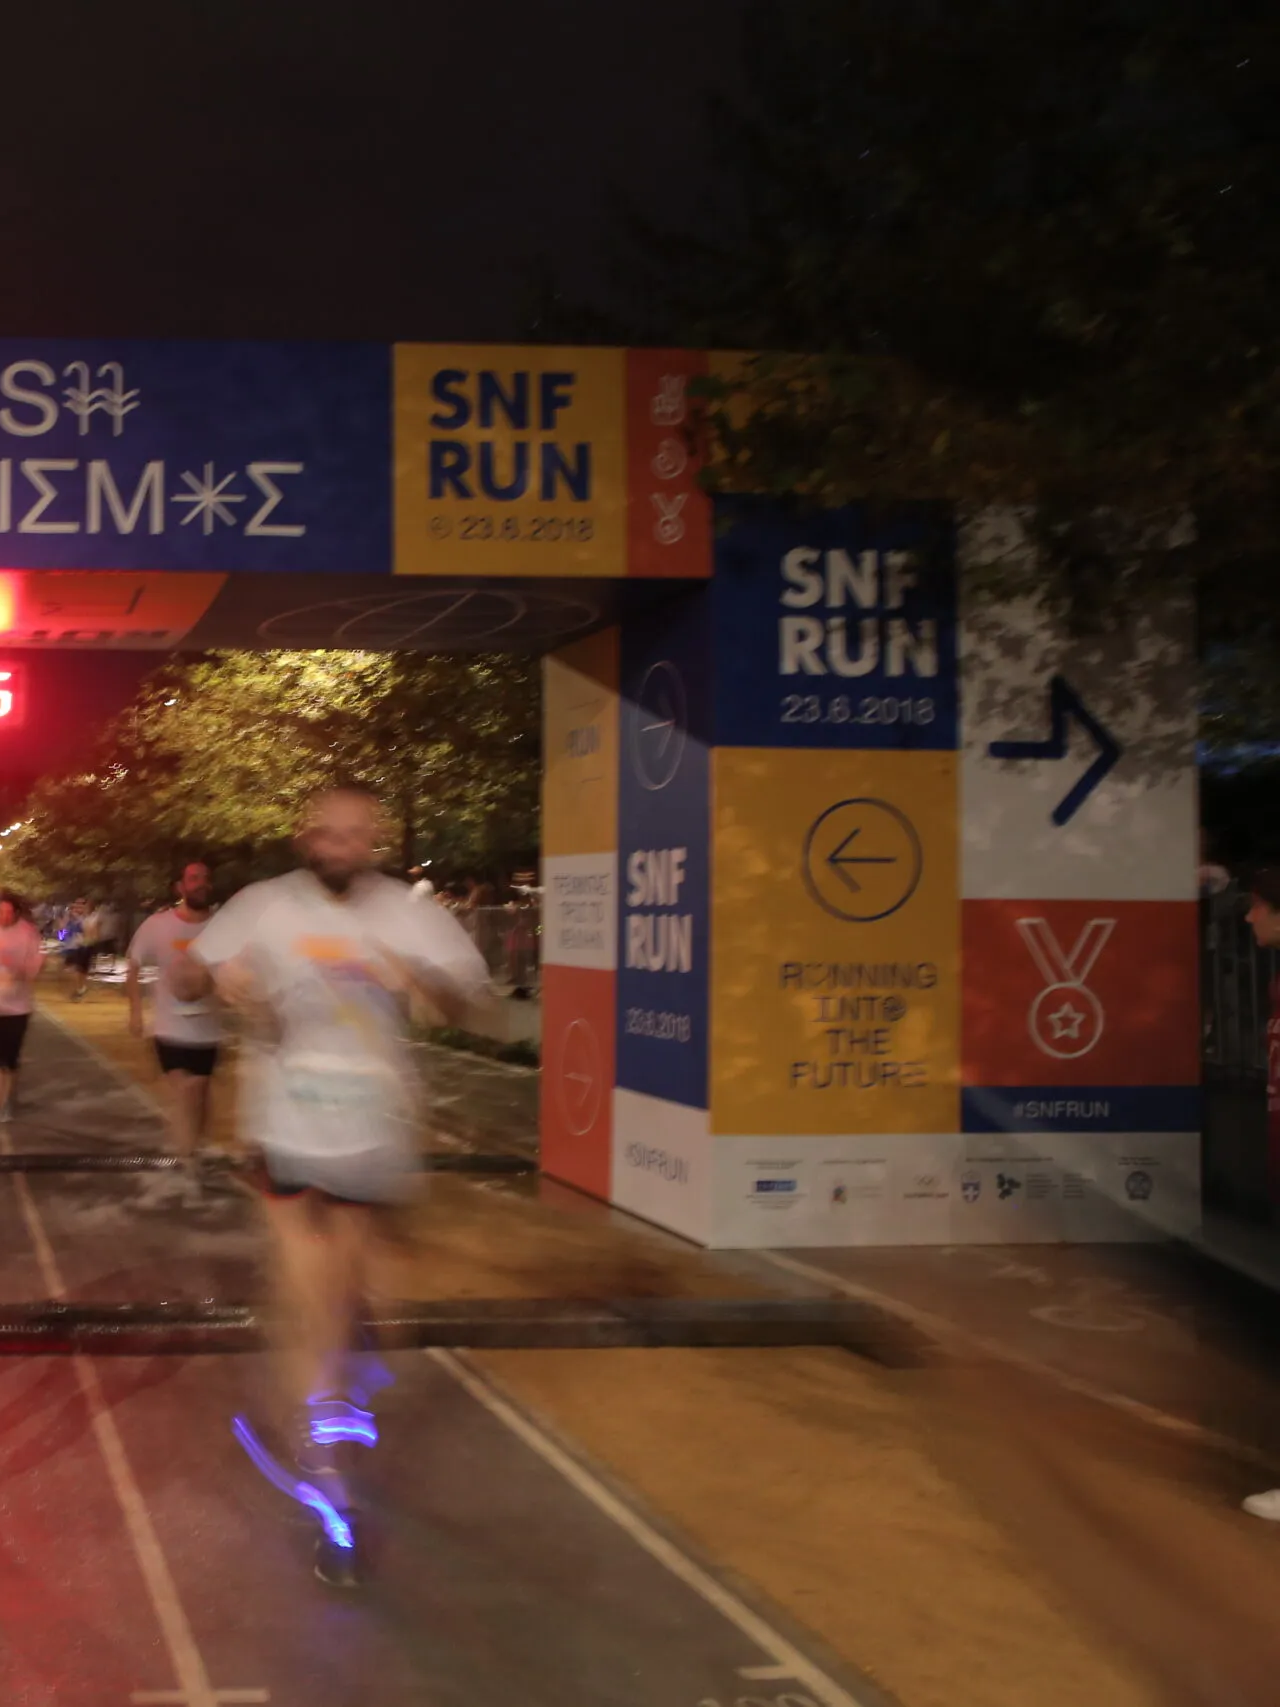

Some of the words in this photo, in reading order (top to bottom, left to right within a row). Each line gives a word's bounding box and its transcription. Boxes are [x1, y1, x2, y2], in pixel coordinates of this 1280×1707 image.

[429, 369, 577, 431] SNF
[428, 440, 592, 501] RUN
[781, 546, 919, 609] SNF
[778, 616, 938, 677] RUN
[780, 694, 935, 725] 23.6.2018
[626, 846, 688, 907] SNF
[625, 913, 693, 973] RUN
[826, 1028, 892, 1055] THE
[789, 1061, 928, 1090] FUTURE
[1013, 1100, 1110, 1119] #SNFRUN
